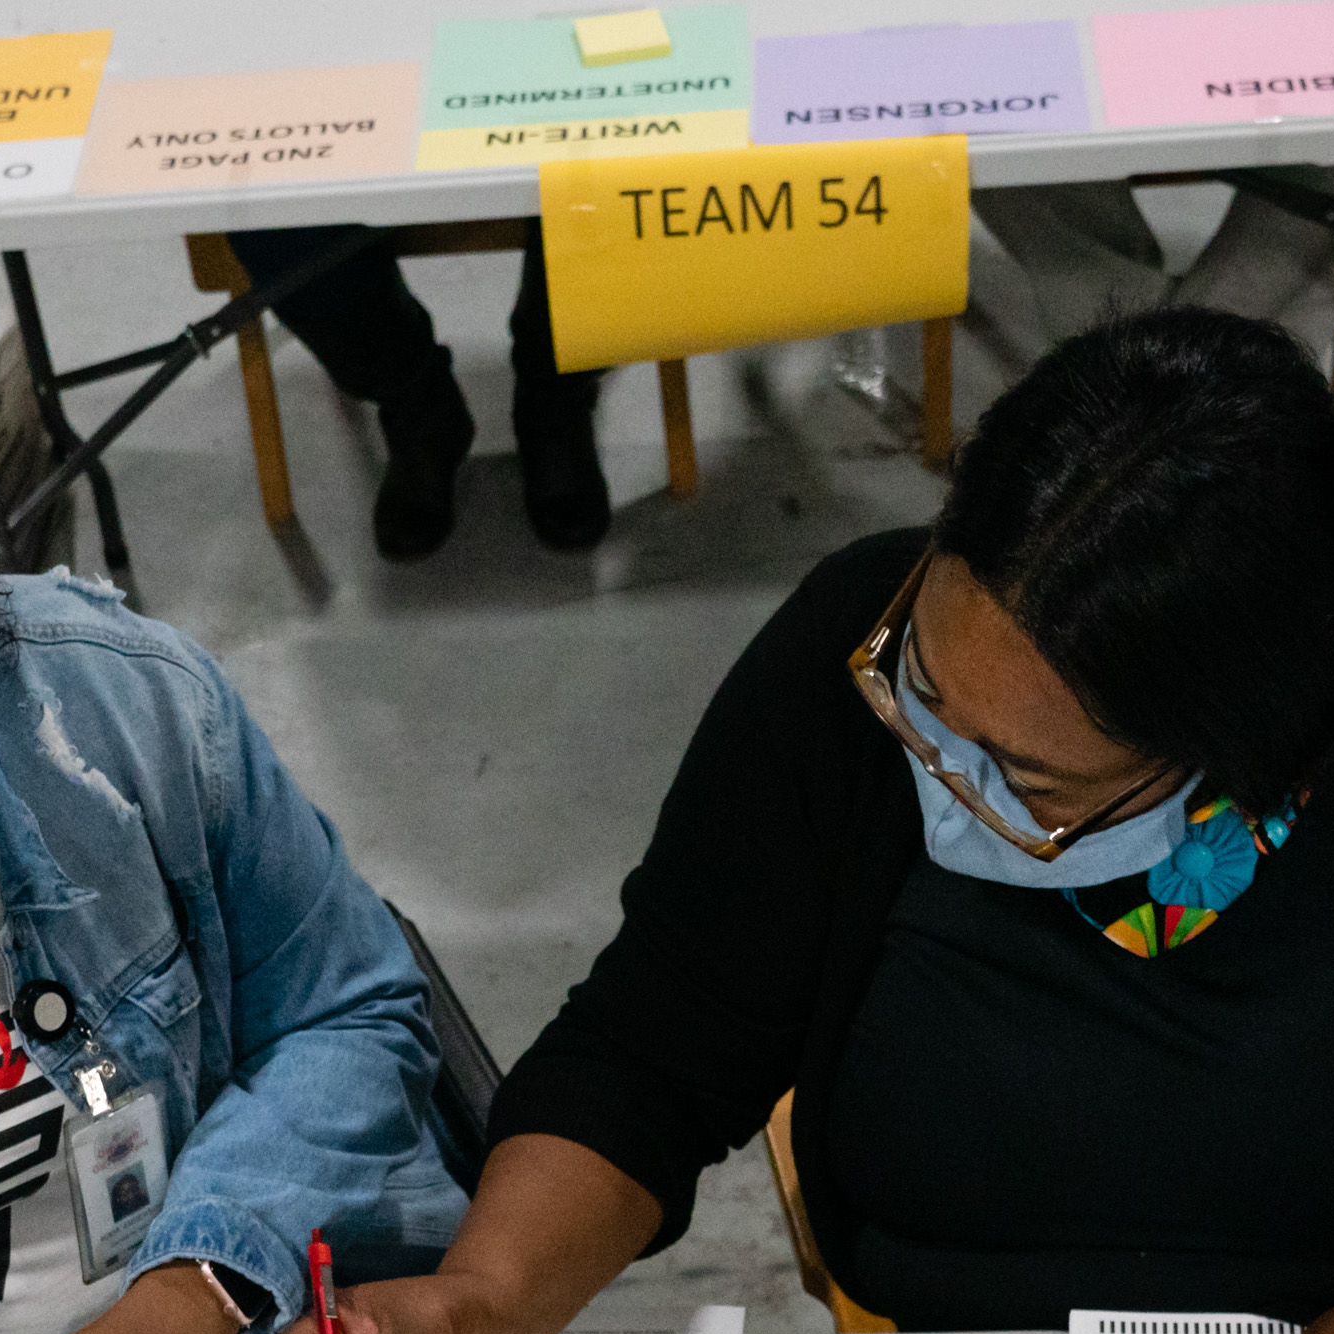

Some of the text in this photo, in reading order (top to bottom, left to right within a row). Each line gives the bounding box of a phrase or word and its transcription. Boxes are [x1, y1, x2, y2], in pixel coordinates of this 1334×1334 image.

[445, 77, 730, 109] UNDETERMINED
[786, 95, 1058, 125] JORGENSEN
[129, 120, 375, 148] BALLOTS ONLY
[486, 120, 681, 146] WRITE-IN
[166, 145, 332, 169] 2ND PAGE
[619, 175, 888, 240] TEAM 54
